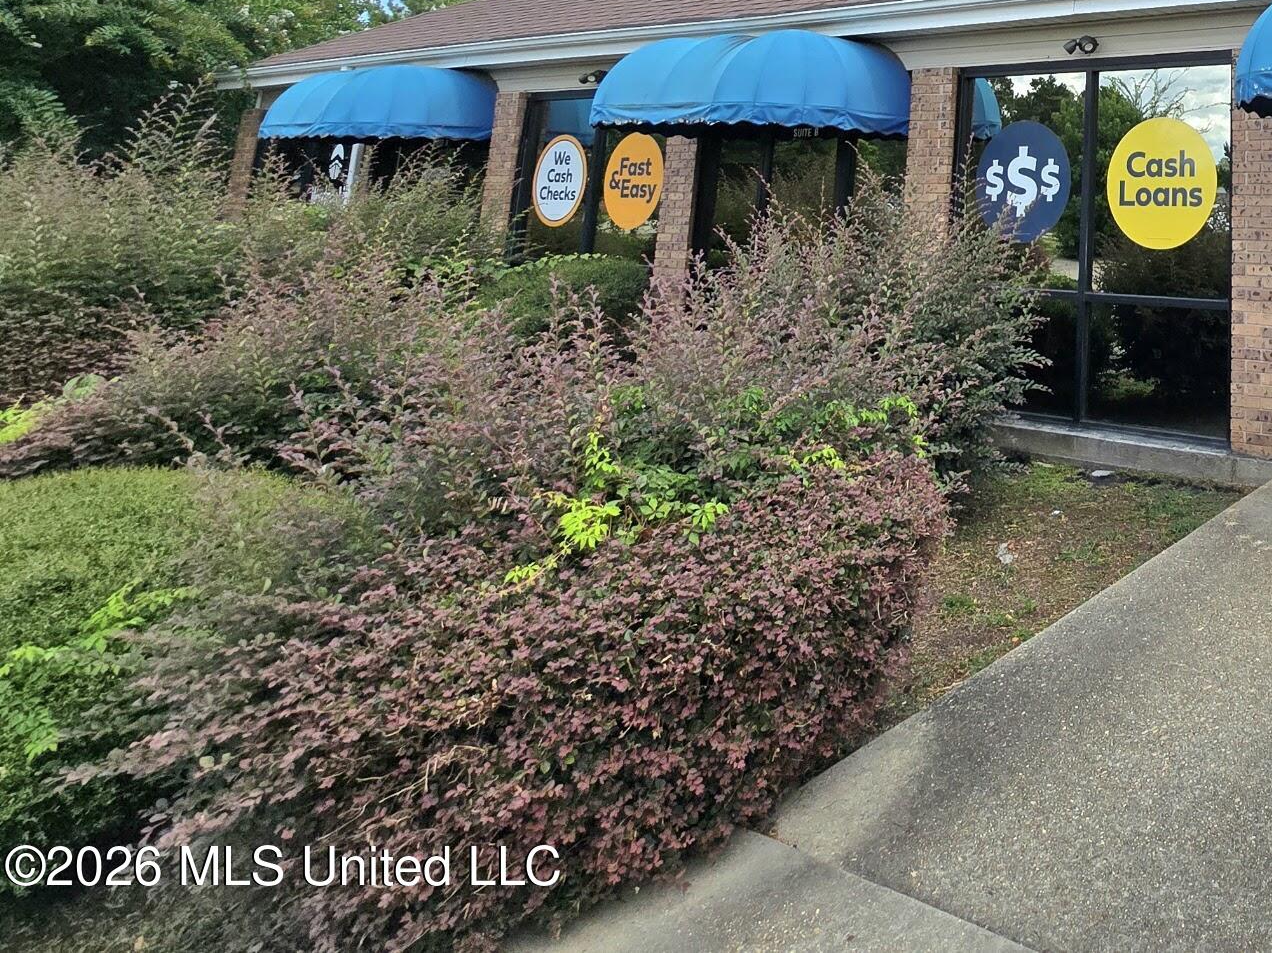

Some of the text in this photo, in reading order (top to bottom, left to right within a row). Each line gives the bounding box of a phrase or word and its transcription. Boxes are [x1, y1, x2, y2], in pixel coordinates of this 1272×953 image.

[793, 127, 812, 137] SUITE
[554, 151, 571, 166] We
[619, 157, 652, 176] Fast
[1126, 150, 1195, 177] Cash
[547, 169, 573, 183] Cash
[539, 186, 576, 201] Checks
[609, 170, 657, 203] & Easy
[1119, 181, 1203, 207] Loans
